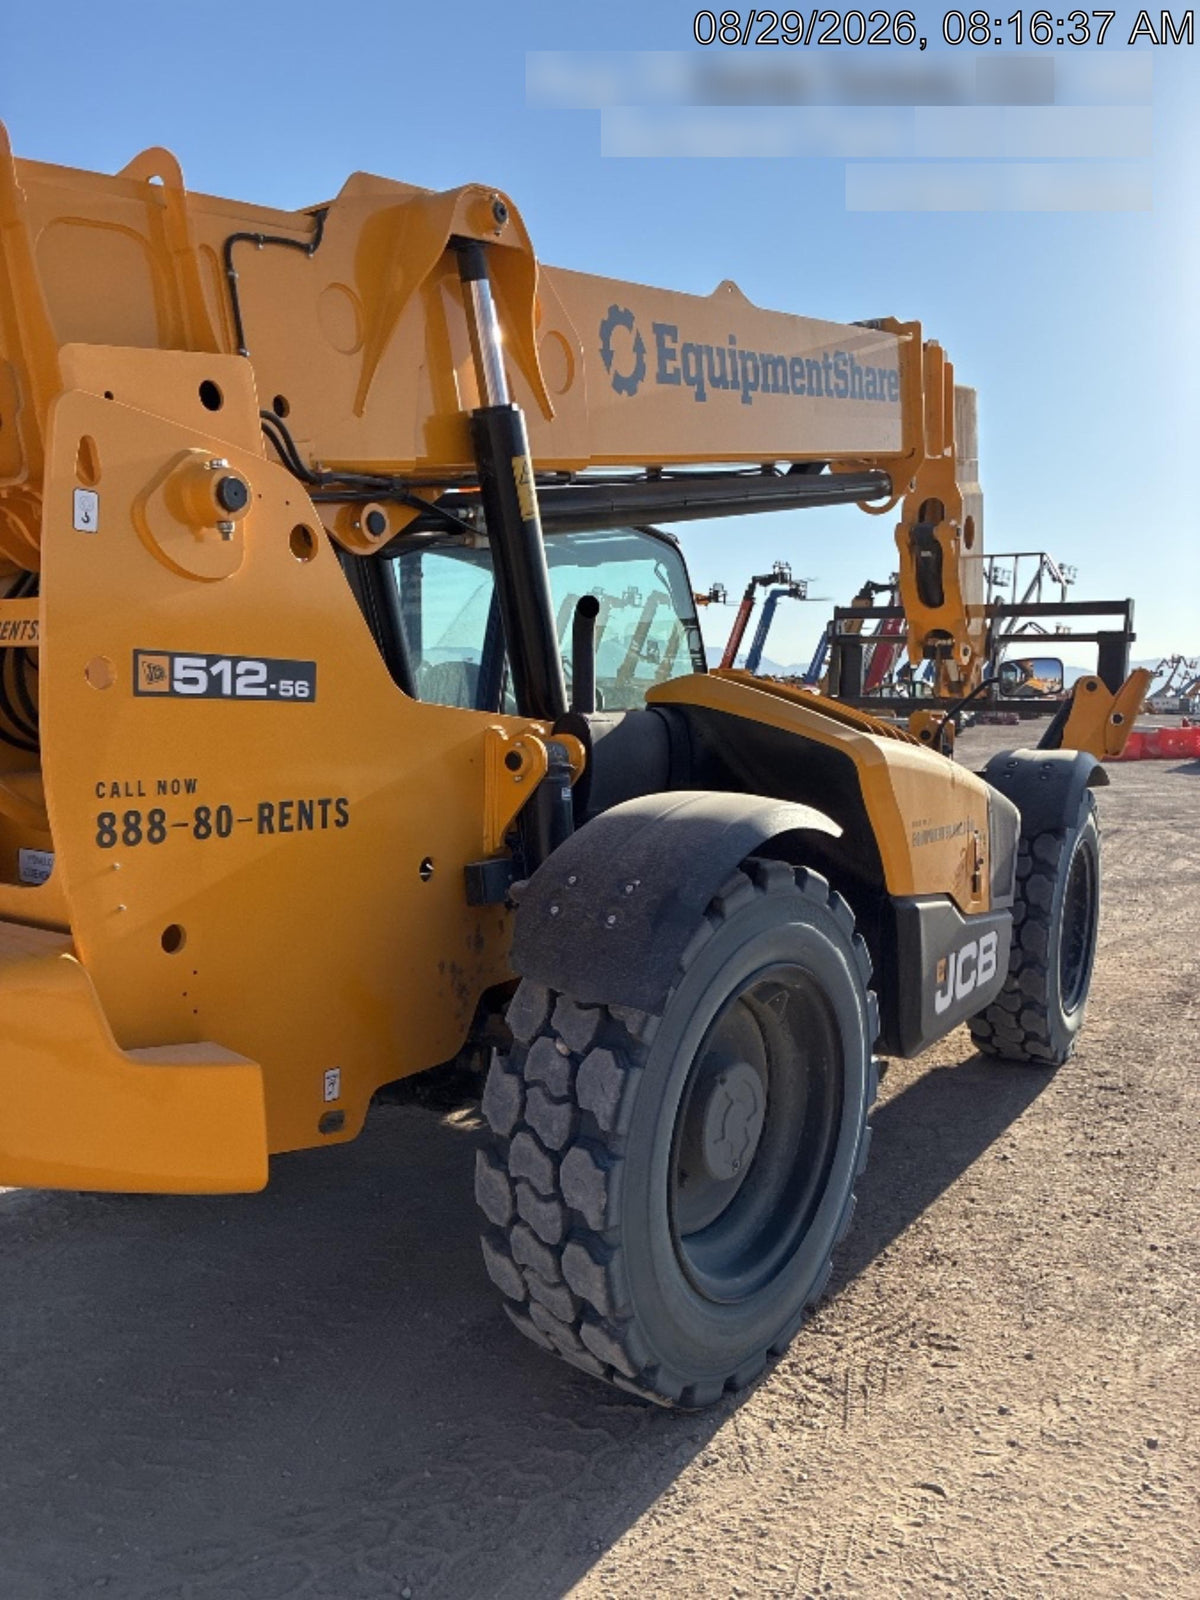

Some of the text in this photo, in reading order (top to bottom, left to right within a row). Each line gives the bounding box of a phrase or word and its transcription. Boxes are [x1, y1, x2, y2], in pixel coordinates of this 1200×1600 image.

[652, 321, 899, 406] EquipmentShare
[95, 778, 198, 798] CALL NOW
[95, 798, 349, 849] 888-80-RENTS
[934, 930, 998, 1014] JCB
